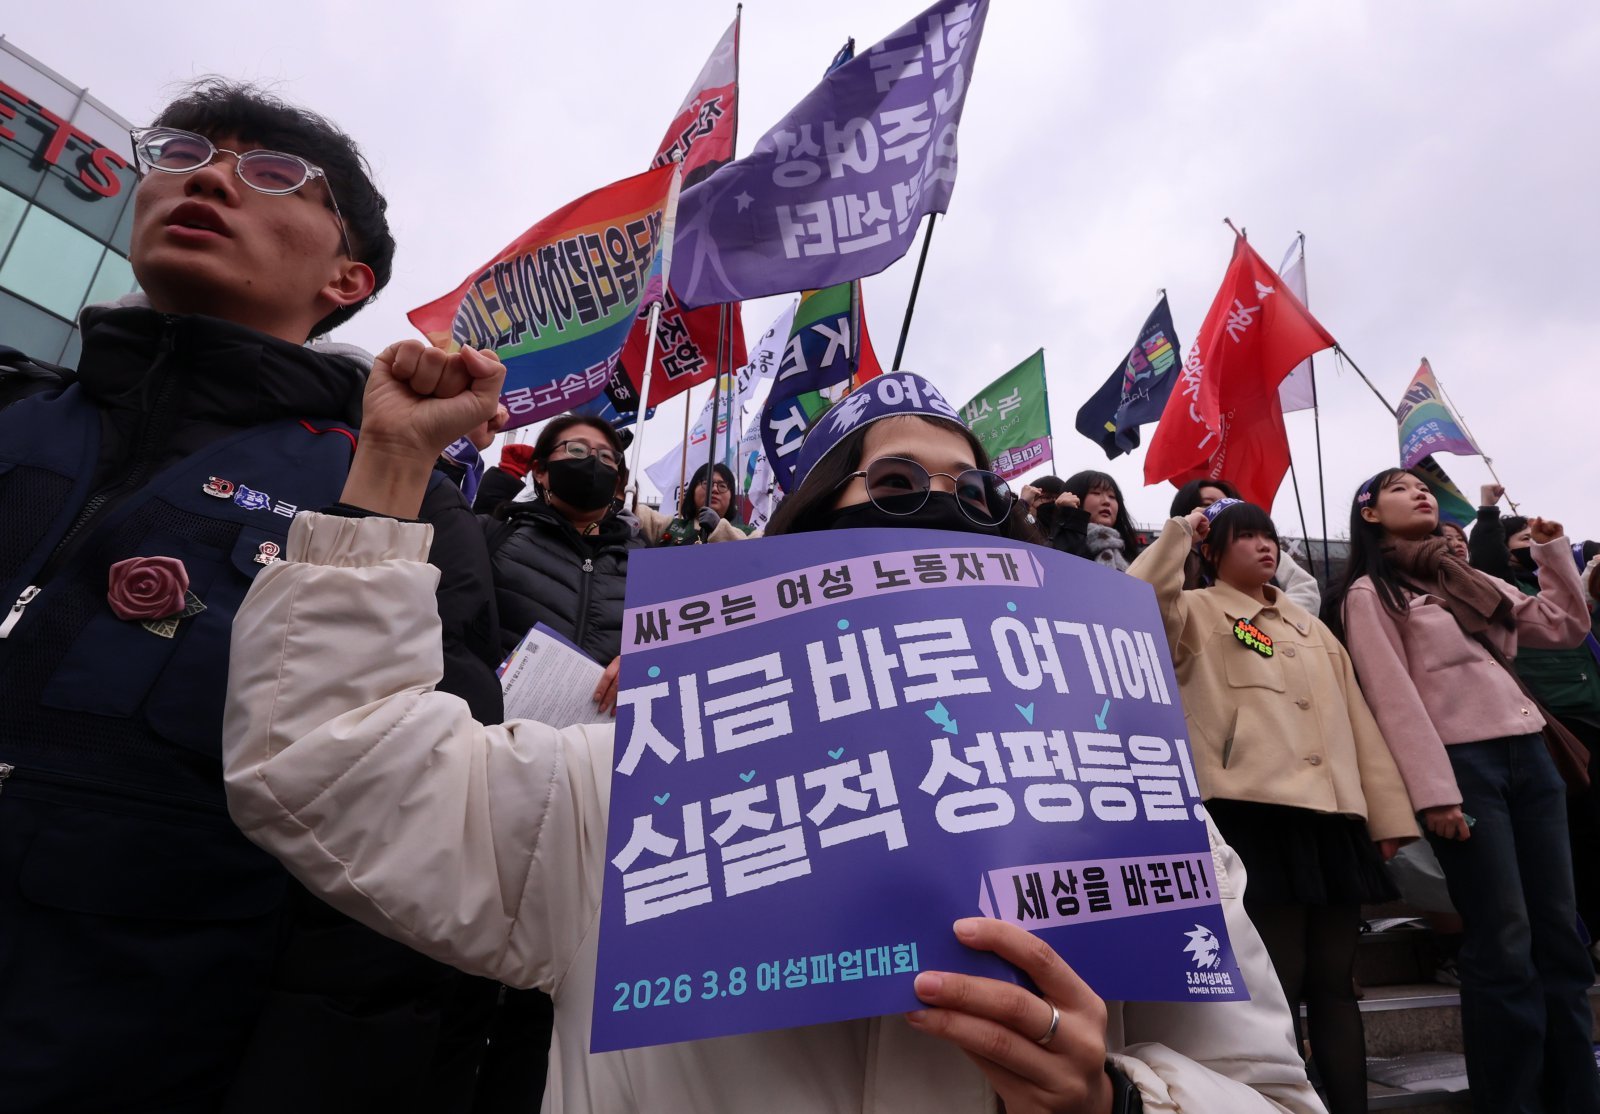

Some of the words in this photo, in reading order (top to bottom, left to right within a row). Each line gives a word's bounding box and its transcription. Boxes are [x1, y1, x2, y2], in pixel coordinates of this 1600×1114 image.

[633, 594, 757, 646] 싸우는
[776, 565, 854, 610] 여성
[874, 552, 1020, 591] 노동자가
[614, 651, 794, 777] 지금
[805, 617, 992, 723] 바로
[988, 613, 1173, 706] 여기에
[610, 749, 909, 927] 실질적
[917, 728, 1206, 835] 성평등을!
[1011, 865, 1114, 924] 세상을
[1120, 858, 1212, 911] 바꾼다!
[612, 974, 693, 1013] 2026
[700, 966, 748, 1001] 3.8
[755, 942, 921, 994] 여성파업대회
[1188, 986, 1210, 994] WOMEN
